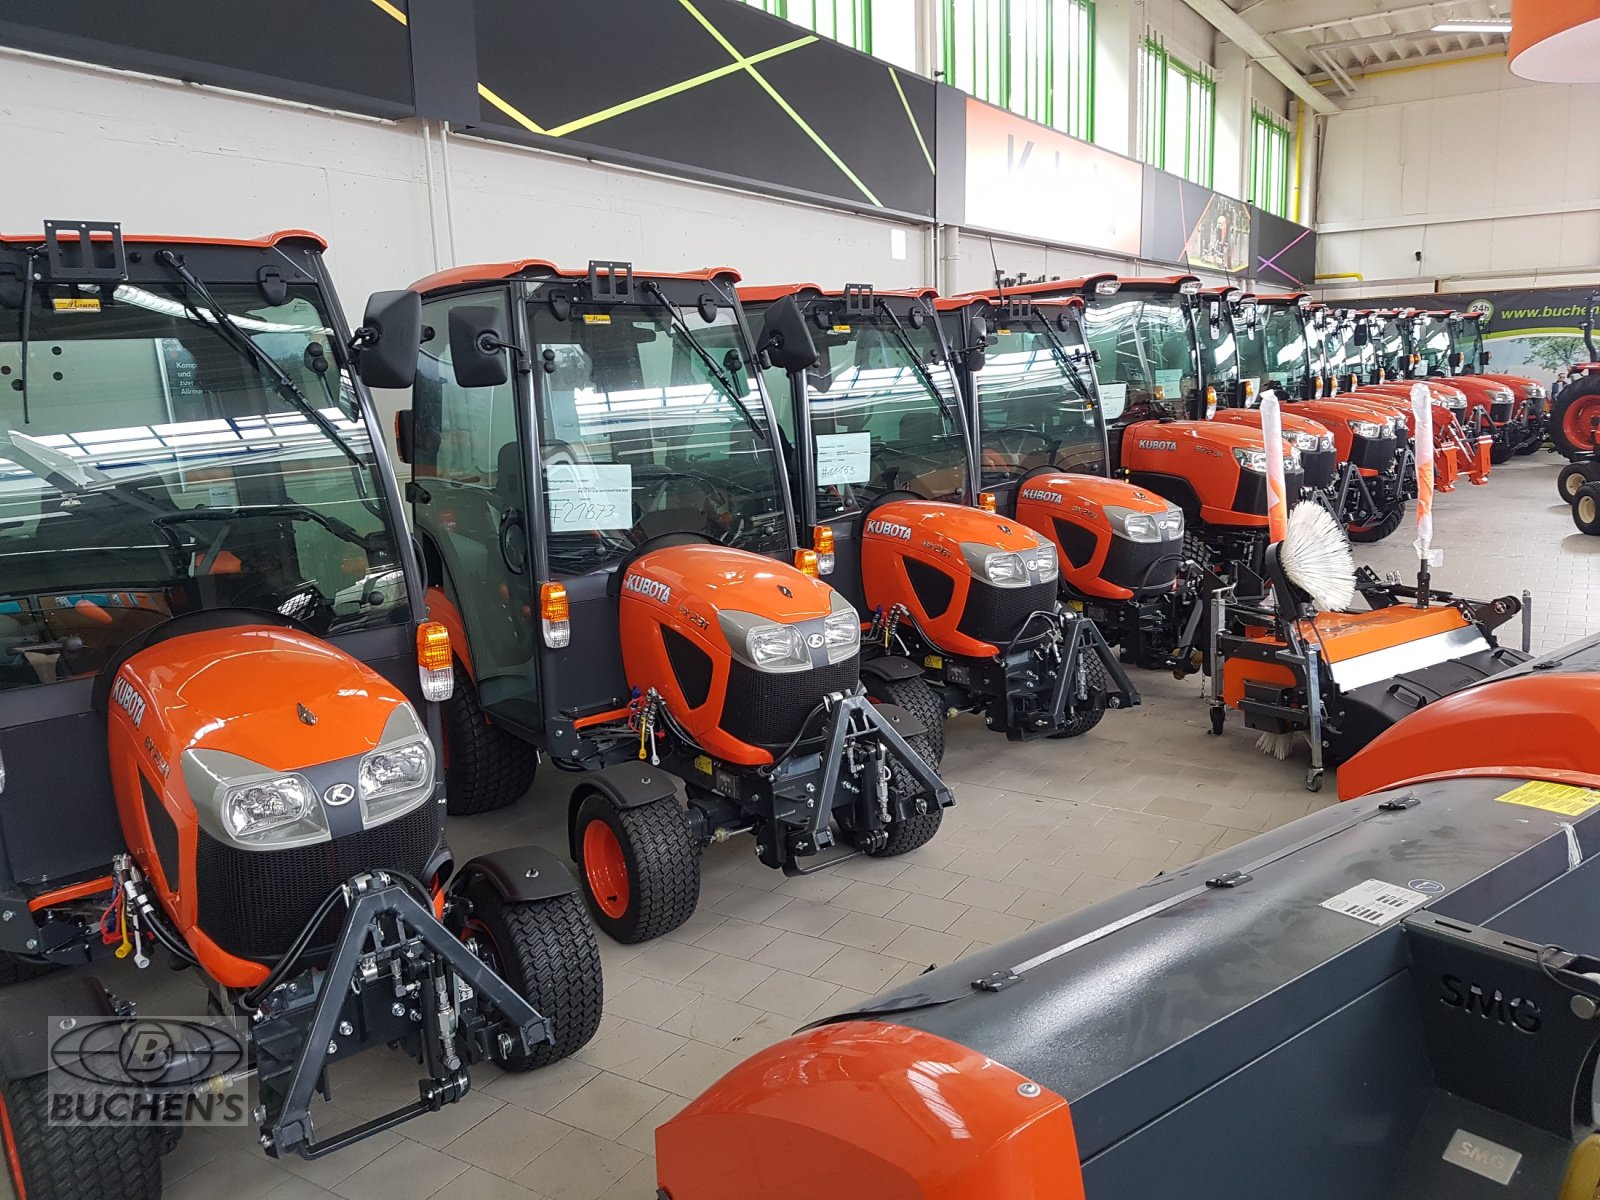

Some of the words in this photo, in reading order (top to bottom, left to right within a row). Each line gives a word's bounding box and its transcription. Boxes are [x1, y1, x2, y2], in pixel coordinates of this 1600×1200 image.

[1472, 304, 1490, 313] 24h
[1139, 439, 1177, 452] KUBOTA
[1022, 489, 1062, 504] KUBOTA
[549, 502, 616, 524] #21873
[866, 520, 912, 541] KUBOTA
[626, 573, 671, 605] KUBOTA
[112, 676, 147, 730] KUBOTA
[1440, 974, 1542, 1034] SMG
[1459, 1141, 1506, 1169] SMG
